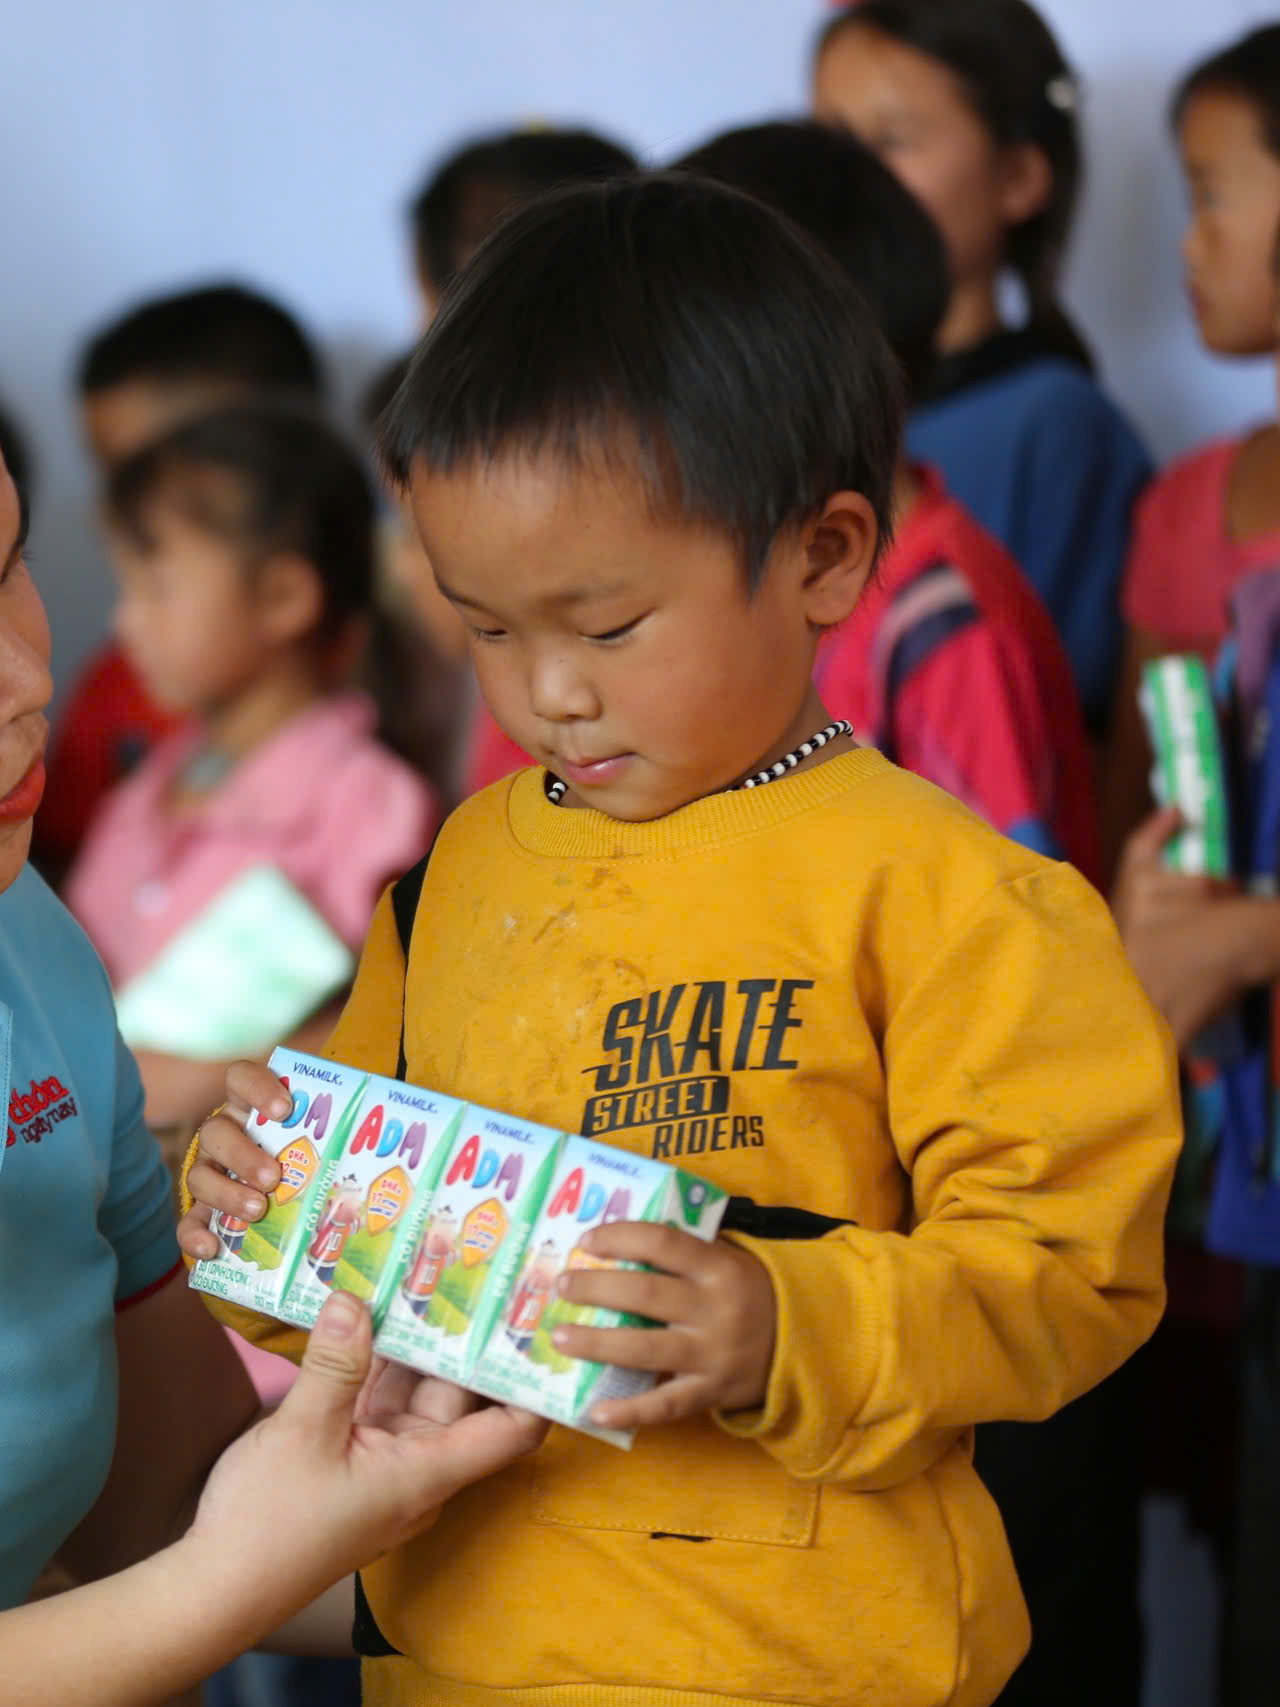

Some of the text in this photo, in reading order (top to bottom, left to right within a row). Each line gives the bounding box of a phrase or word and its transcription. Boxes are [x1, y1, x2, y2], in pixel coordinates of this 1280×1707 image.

[581, 979, 815, 1091] SKATE
[293, 1062, 341, 1085] VINAMILK
[388, 1089, 435, 1113] VINAMILK
[256, 1076, 332, 1140] DM
[589, 1079, 719, 1132] STREET
[350, 1105, 427, 1170] ADM
[652, 1115, 764, 1159] RIDERS
[446, 1135, 524, 1201] ADM
